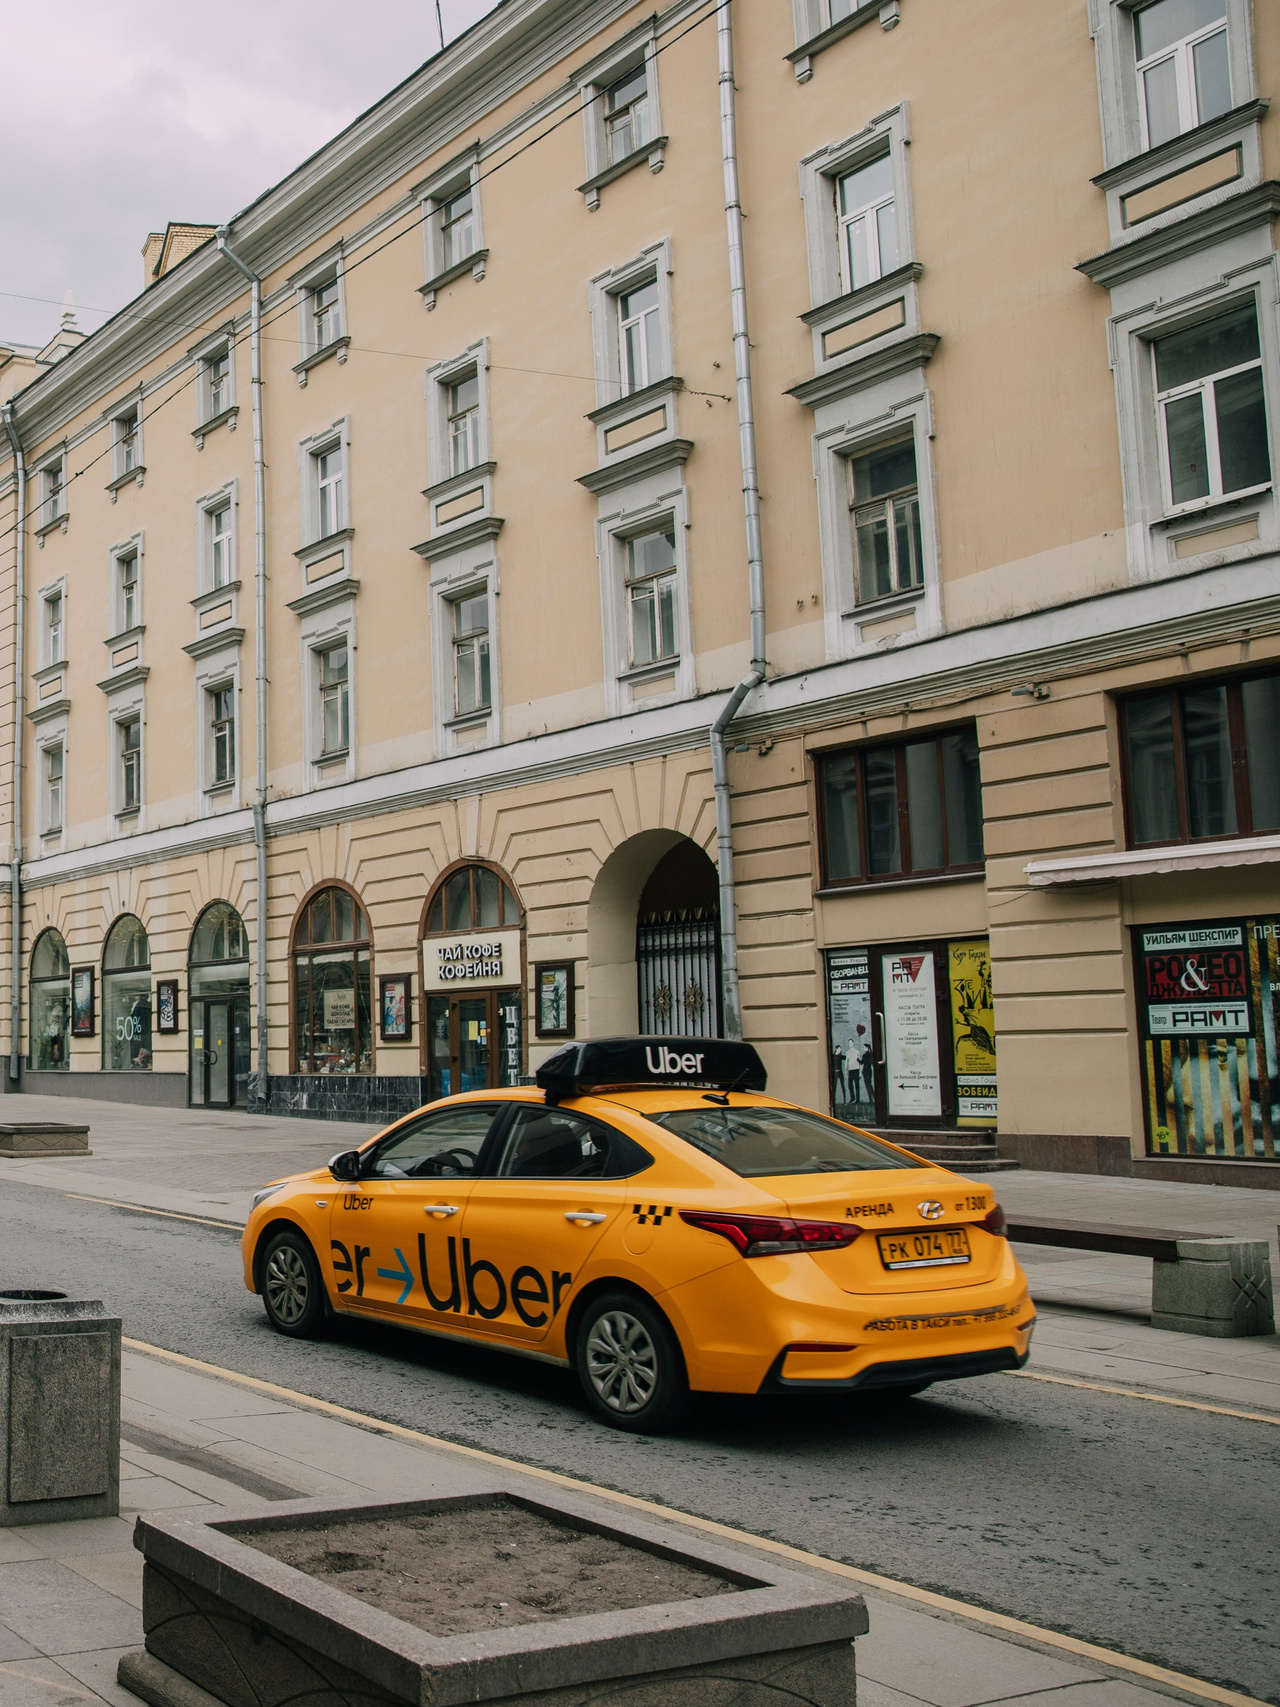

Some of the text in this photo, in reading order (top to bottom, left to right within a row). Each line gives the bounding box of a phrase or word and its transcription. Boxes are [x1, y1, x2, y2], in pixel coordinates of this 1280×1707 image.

[1145, 929, 1239, 946] УИЛЬЯМ ШЕКСПИР
[437, 942, 501, 961] ЧАЙ КОФЕ
[437, 960, 502, 979] КОФЕЙНЯ
[841, 982, 867, 990] РАМТ
[1172, 1009, 1245, 1027] РАМТ
[116, 1016, 142, 1041] 50%
[645, 1046, 704, 1074] Uber
[343, 1194, 374, 1211] Uber
[845, 1203, 895, 1218] АРЕНДА
[965, 1196, 987, 1211] 1300
[913, 1234, 944, 1257] 074
[946, 1232, 961, 1248] 77
[417, 1232, 572, 1328] Uber
[863, 1319, 909, 1332] РАБОТА
[911, 1320, 919, 1330] В
[921, 1318, 950, 1330] ТАКСИ
